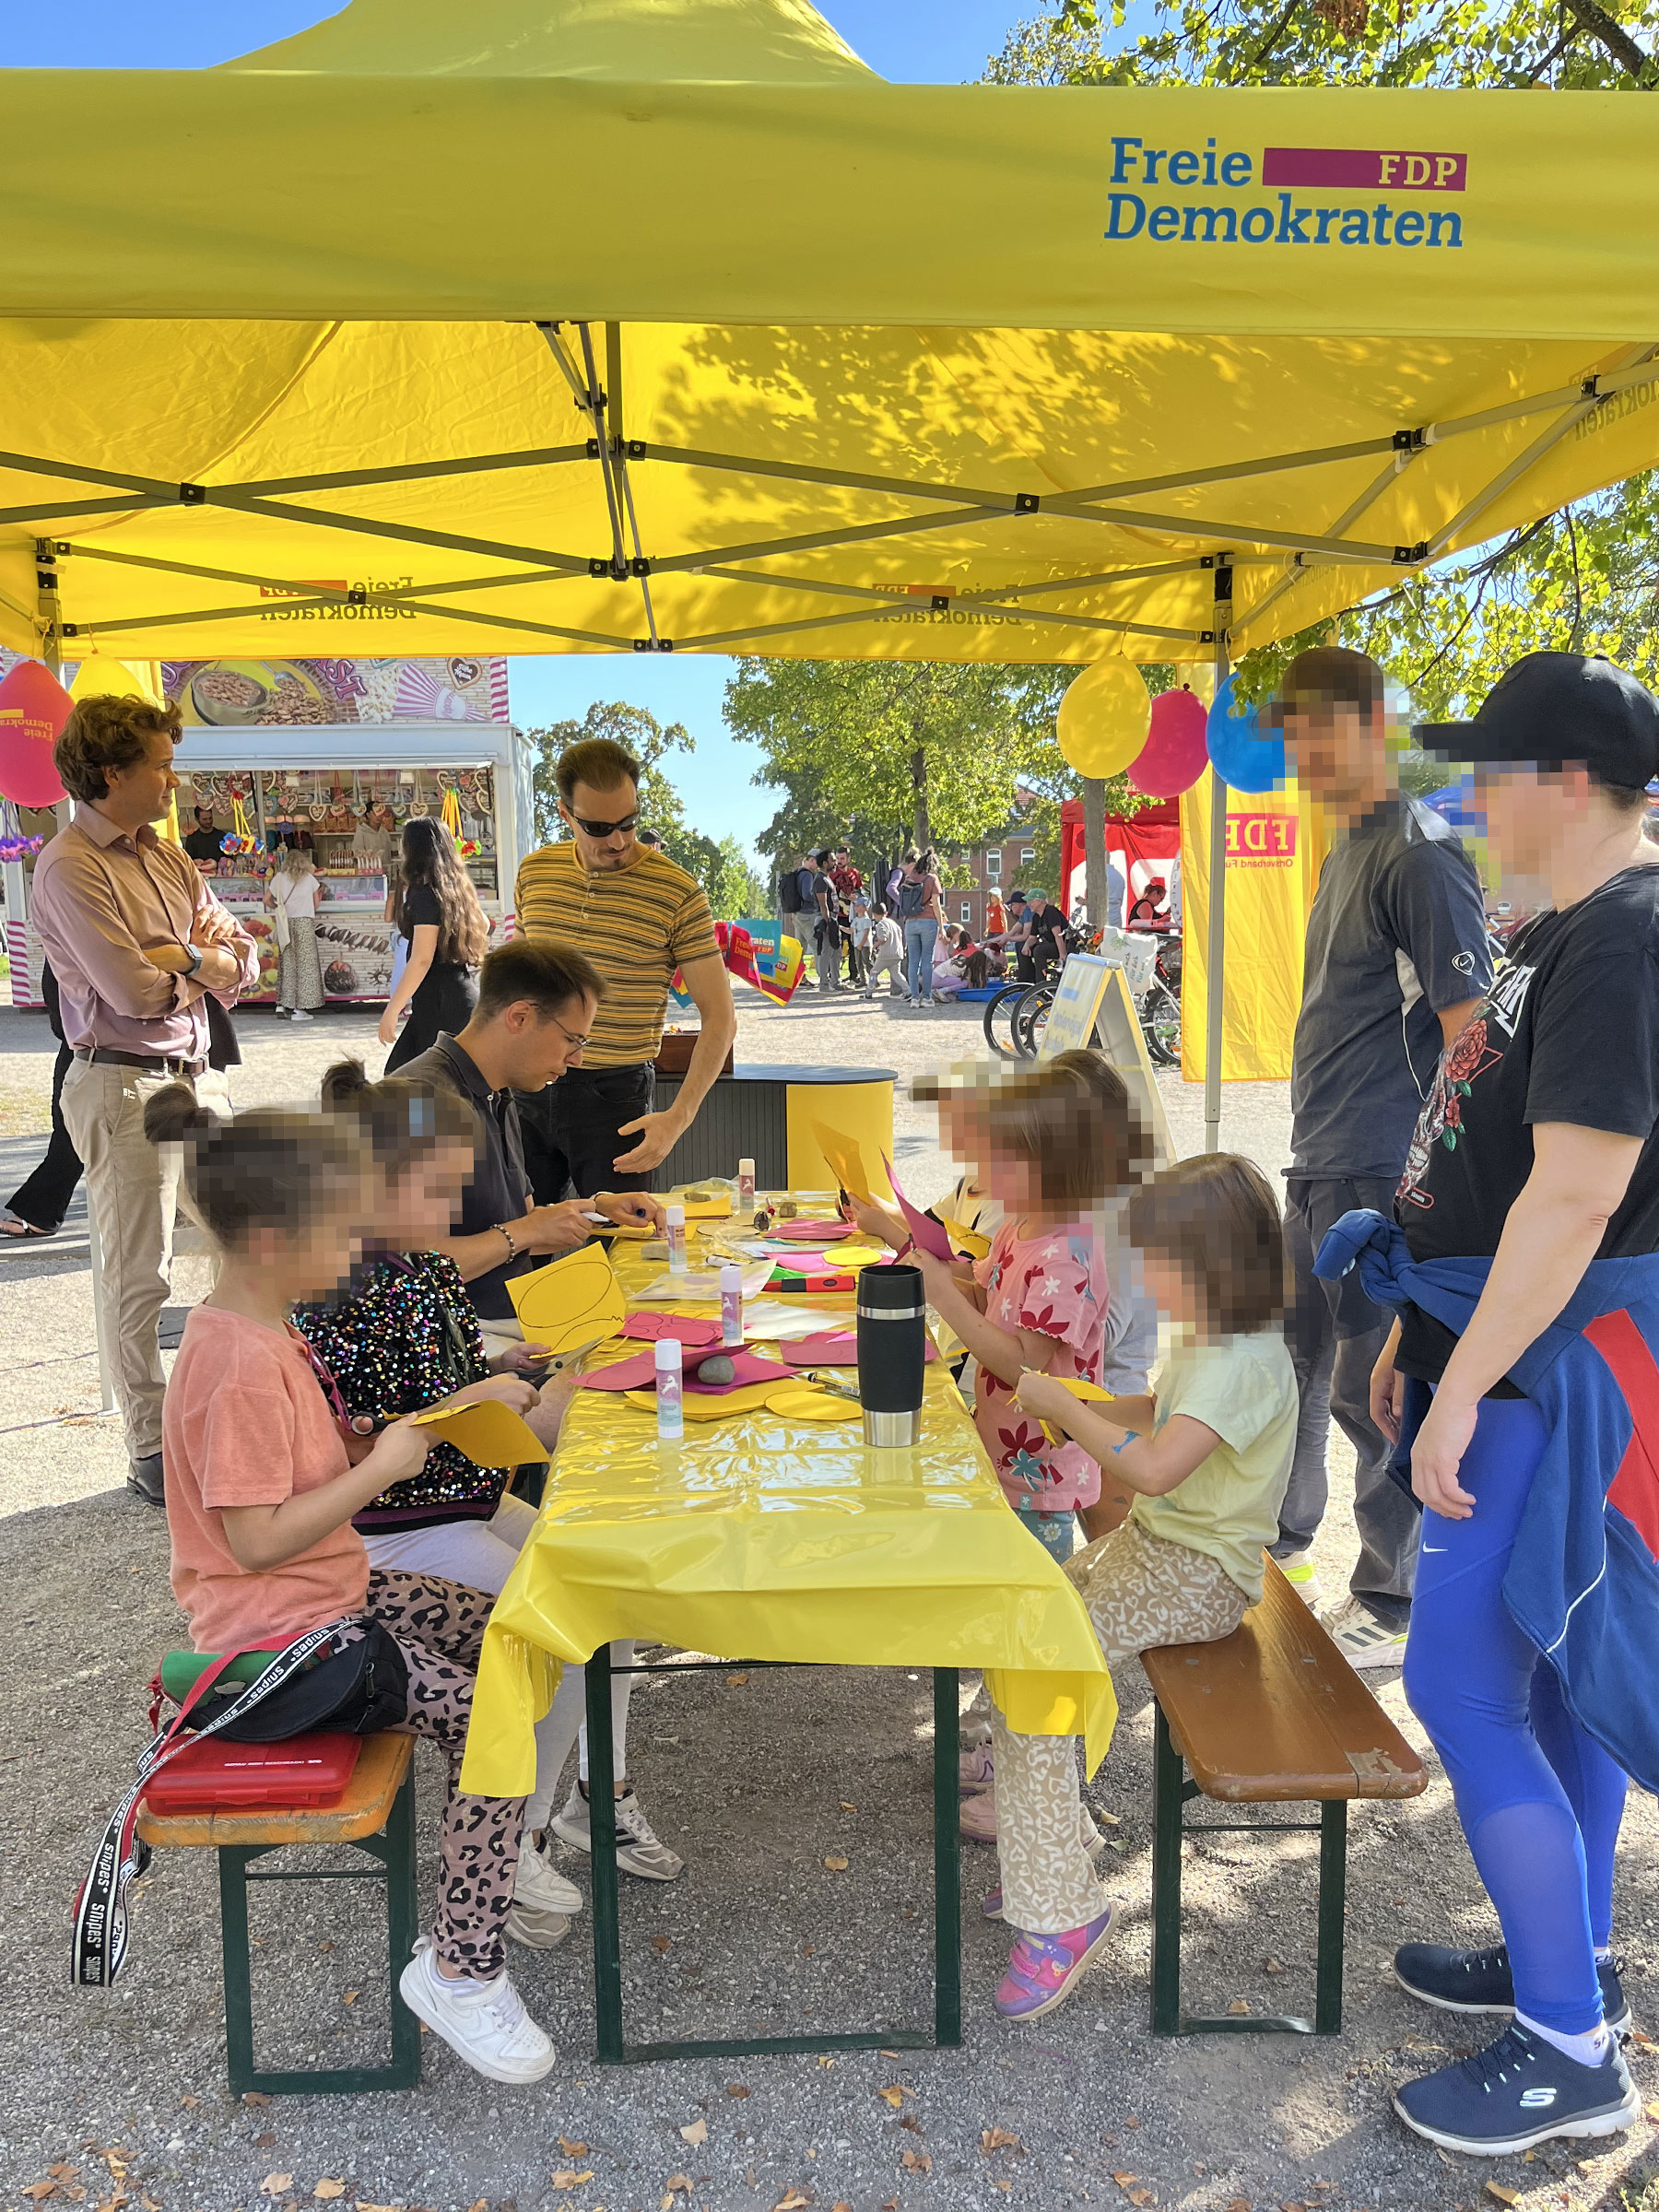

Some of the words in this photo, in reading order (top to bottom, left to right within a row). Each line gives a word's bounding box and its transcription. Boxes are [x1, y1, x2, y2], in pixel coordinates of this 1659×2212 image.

[1109, 136, 1253, 186] Freie
[1378, 155, 1458, 186] FDP
[1104, 193, 1464, 248] Demokraten
[292, 1629, 330, 1658] snipes
[251, 1665, 285, 1700] snipes
[98, 1842, 114, 1887] snipes
[86, 1902, 106, 1944] snipes
